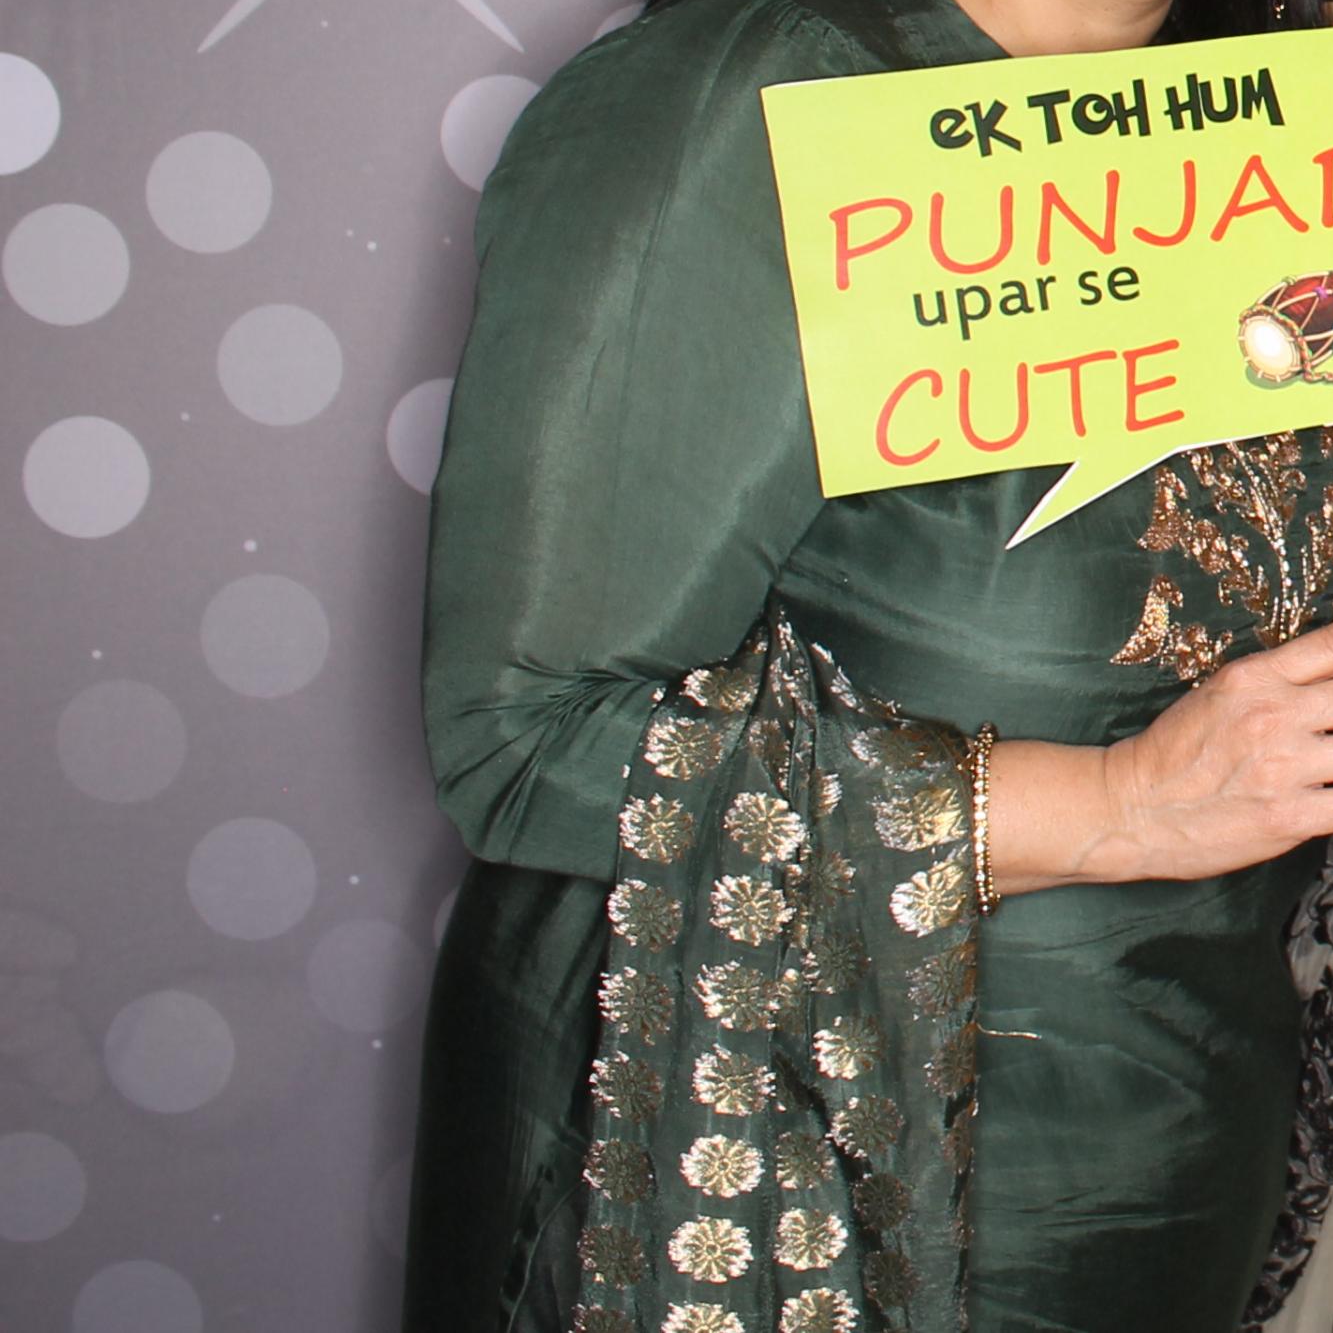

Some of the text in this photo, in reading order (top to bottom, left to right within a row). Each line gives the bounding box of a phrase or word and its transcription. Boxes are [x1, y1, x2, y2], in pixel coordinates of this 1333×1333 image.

[1027, 78, 1151, 145] TOH
[1164, 67, 1286, 132] HUM
[913, 265, 1141, 341] upar se
[875, 339, 1185, 467] CUTE
